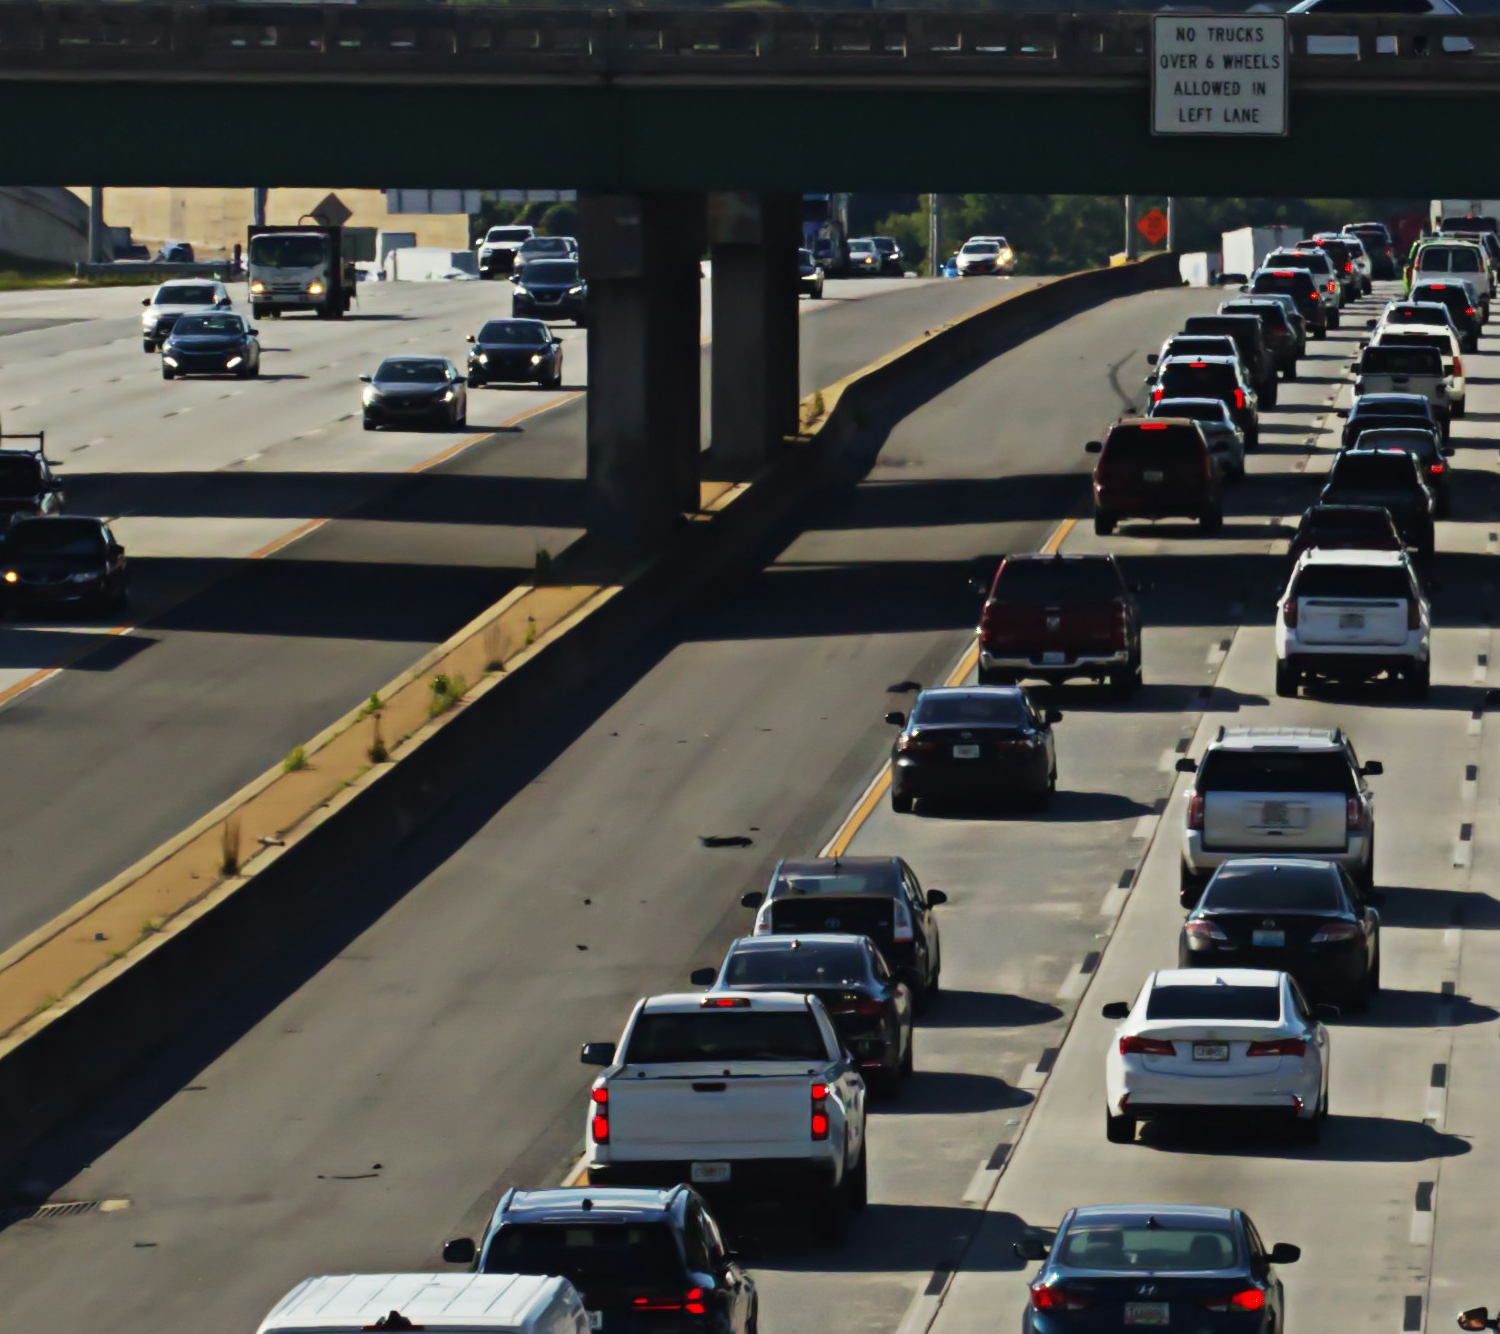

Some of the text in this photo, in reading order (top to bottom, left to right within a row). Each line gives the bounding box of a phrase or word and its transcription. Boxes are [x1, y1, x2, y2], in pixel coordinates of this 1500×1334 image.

[1176, 27, 1264, 42] NO TRUCKS
[1160, 54, 1280, 69] OVER 6 WHEELS
[1174, 81, 1266, 96] ALLOWED IN
[1179, 108, 1259, 123] LEFT LANE
